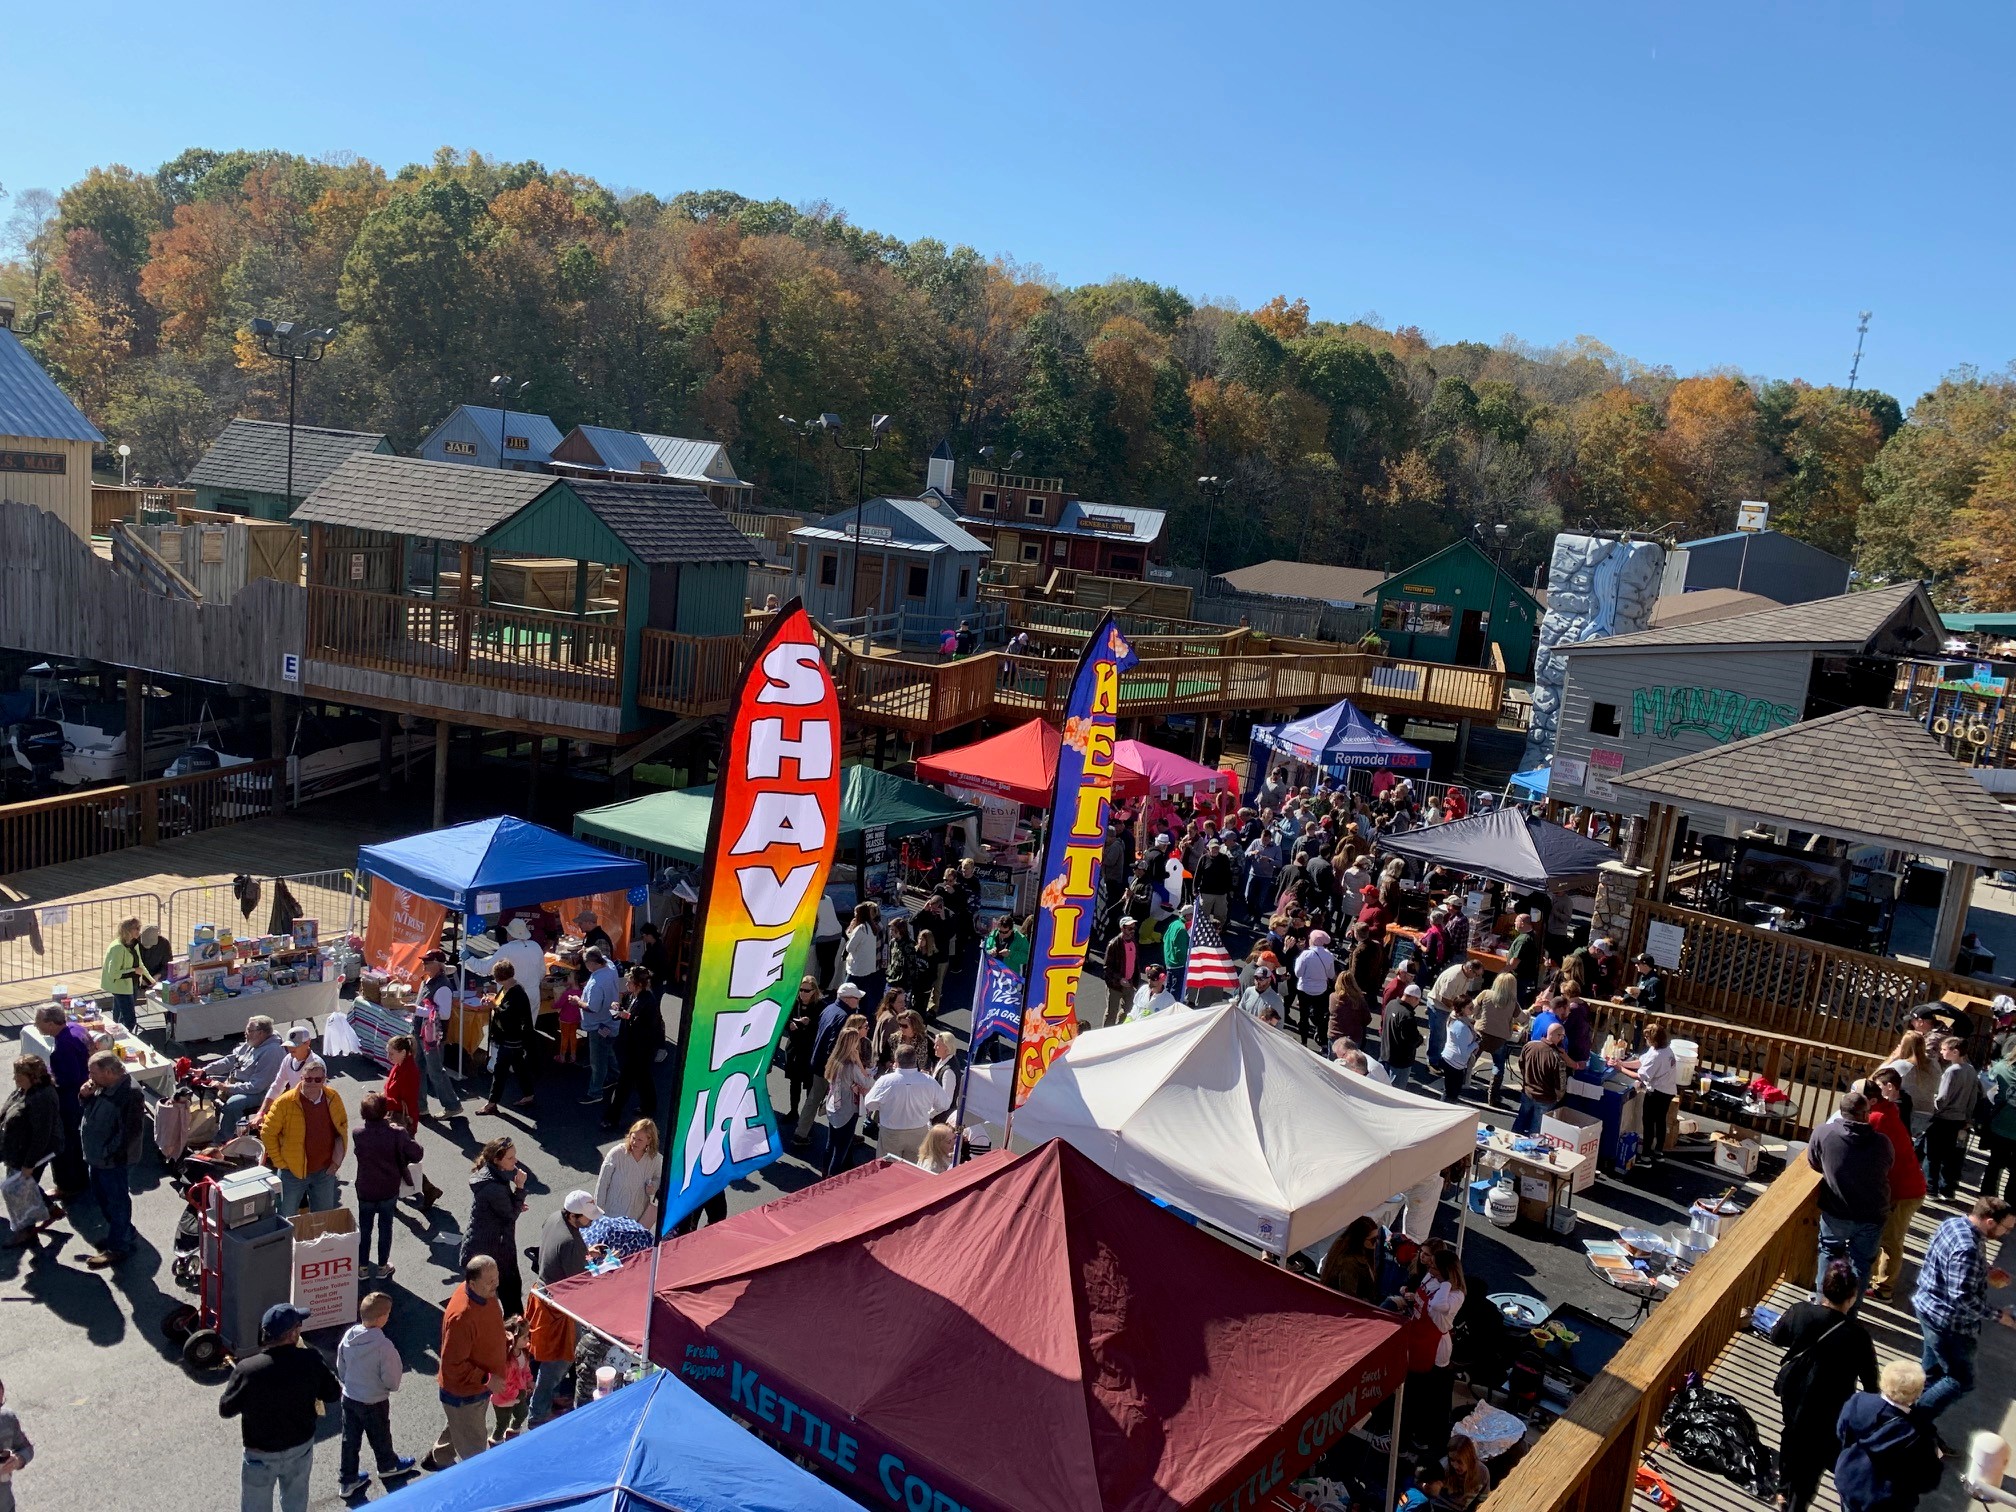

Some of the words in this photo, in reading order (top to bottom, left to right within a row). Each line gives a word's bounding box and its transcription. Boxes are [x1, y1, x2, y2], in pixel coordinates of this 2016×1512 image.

[447, 441, 472, 454] JAIL
[848, 525, 869, 534] FREGHT
[1080, 520, 1109, 529] GENERAL
[1112, 523, 1132, 531] STORE
[286, 656, 296, 673] E
[1633, 686, 1798, 744] MANGOS
[1335, 752, 1388, 766] Remodel
[1392, 755, 1417, 766] USA
[959, 772, 980, 783] Franklin
[1580, 1138, 1598, 1154] BTR
[301, 1257, 352, 1280] BTR
[303, 1285, 329, 1294] Portable
[331, 1281, 350, 1290] Toilets
[309, 1295, 343, 1306] Containers
[310, 1305, 326, 1313] Front
[328, 1302, 343, 1310] Load
[681, 1361, 725, 1381] Popped
[730, 1360, 859, 1474] KETTLE
[1298, 1386, 1358, 1456] CORN
